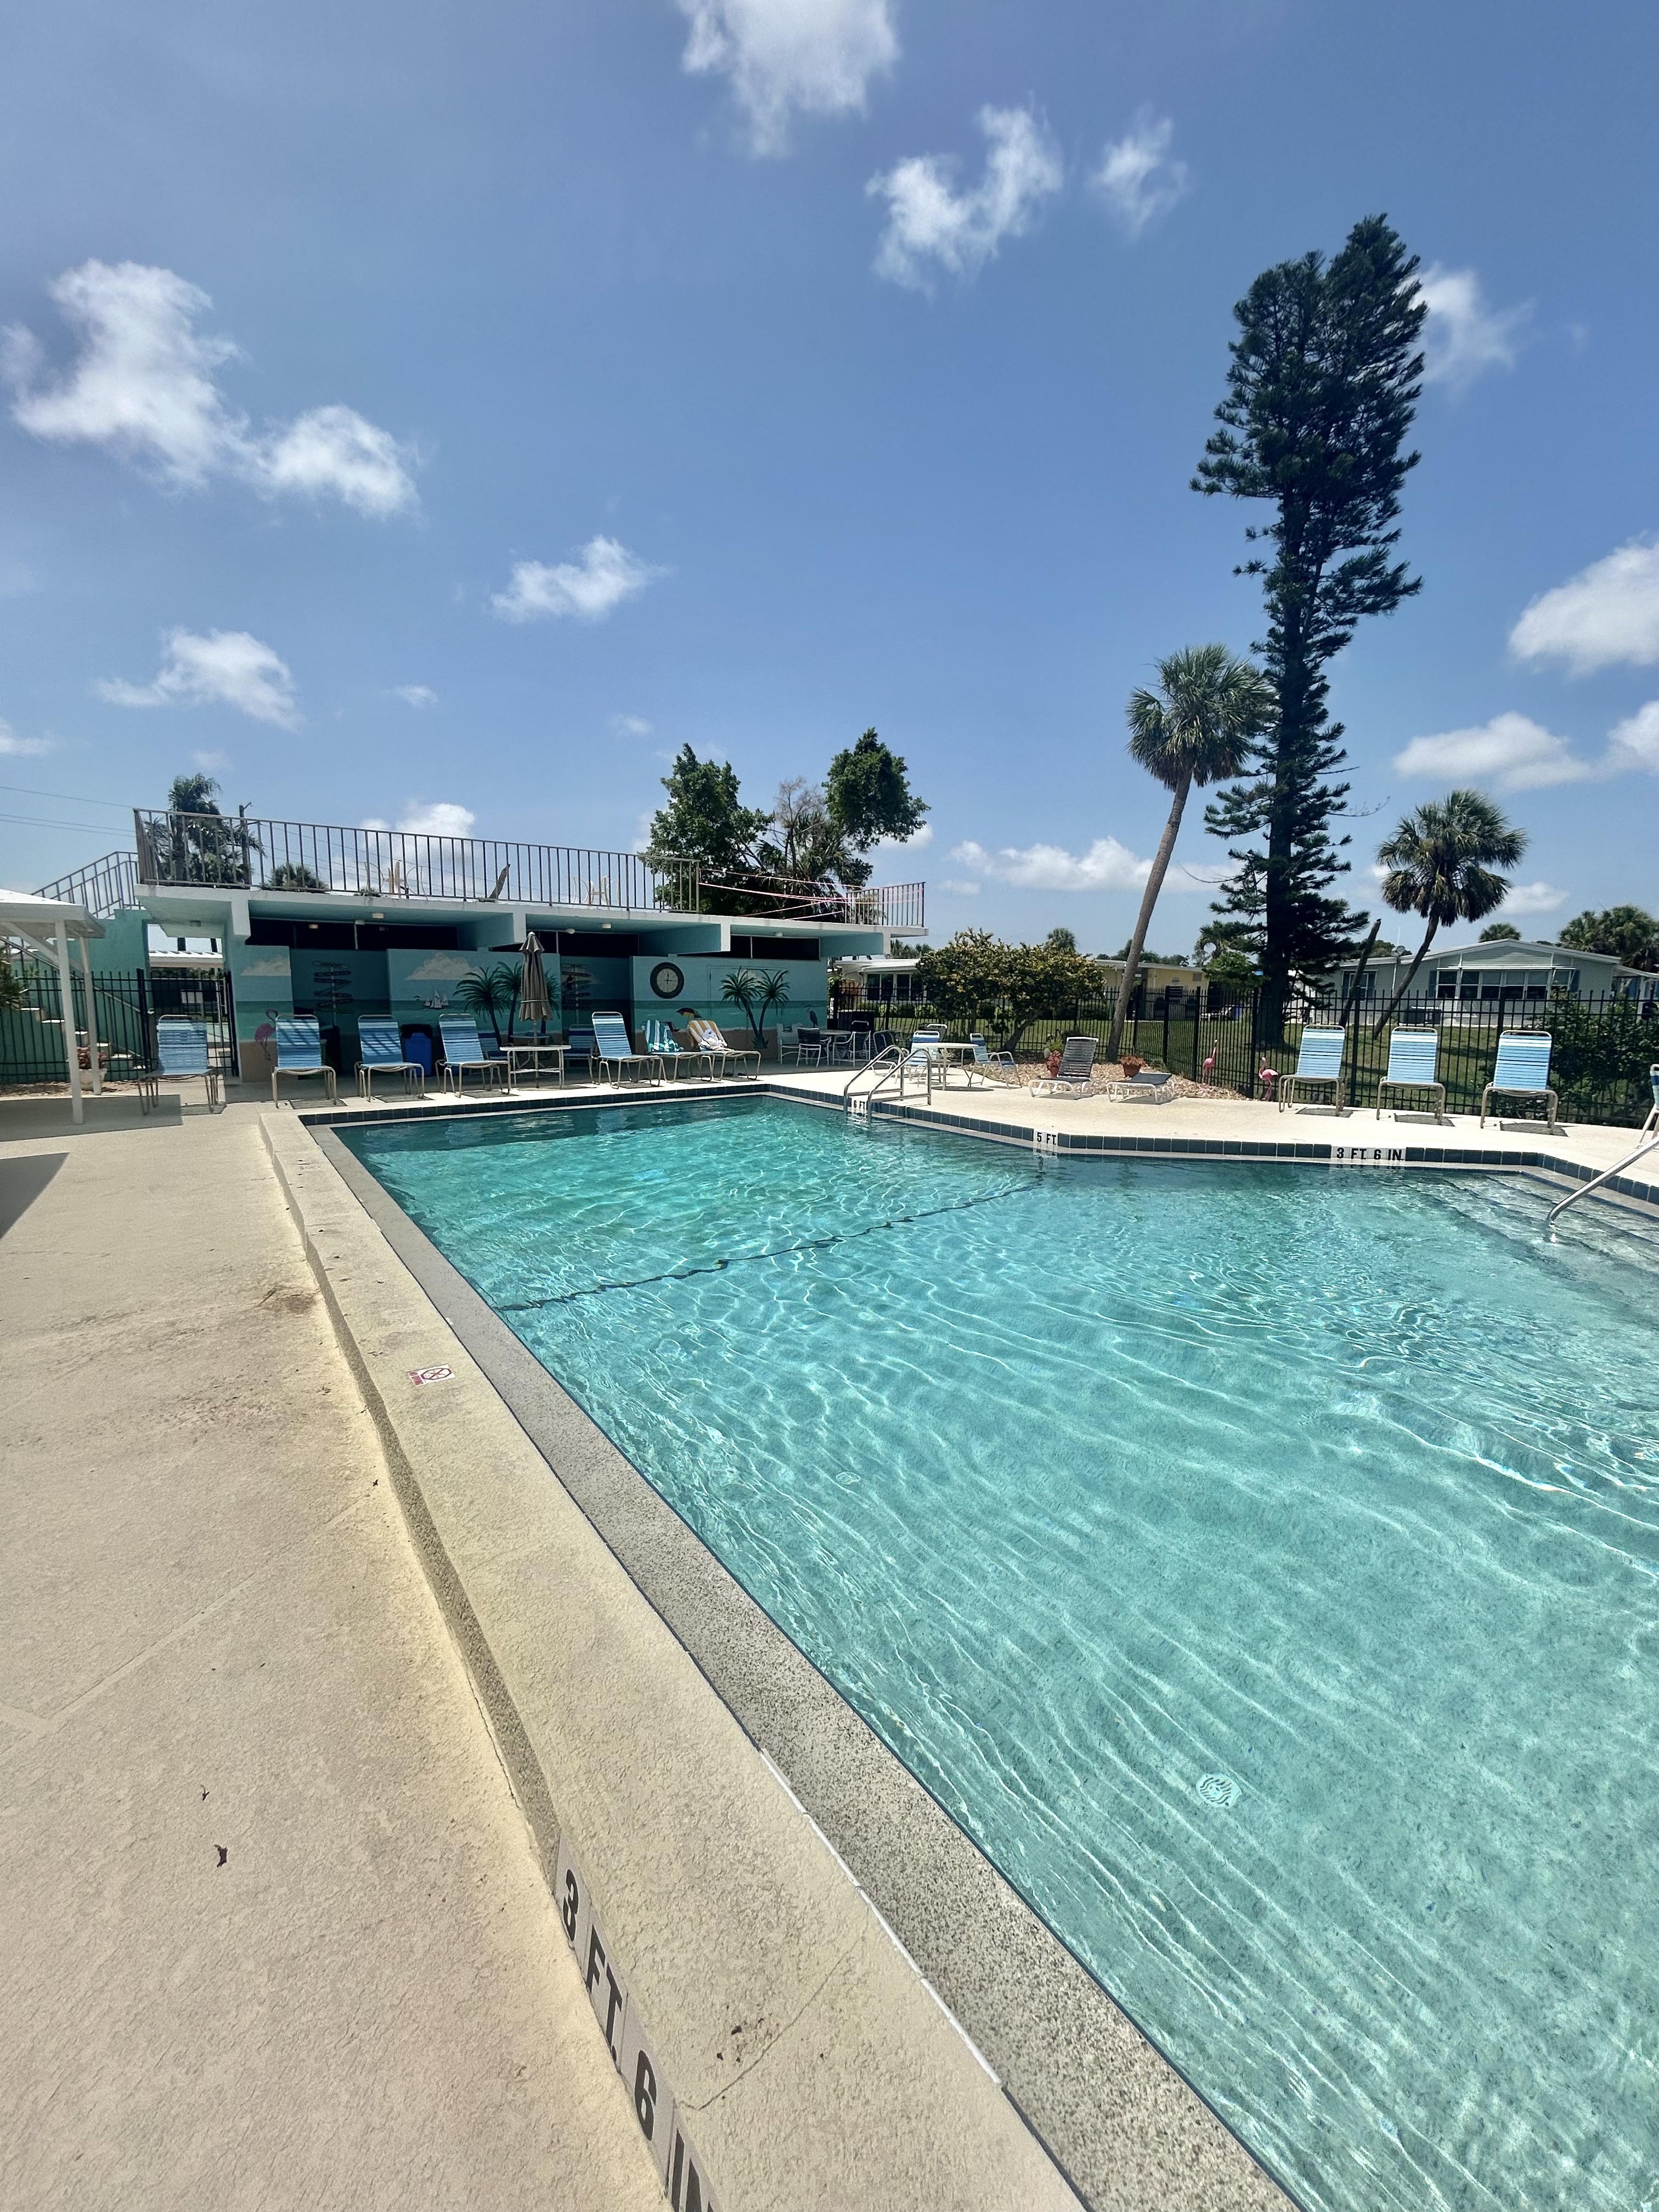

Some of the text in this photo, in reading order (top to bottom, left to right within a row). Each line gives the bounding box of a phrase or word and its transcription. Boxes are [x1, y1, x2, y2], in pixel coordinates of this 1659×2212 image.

[1037, 1132, 1042, 1142] 5
[1336, 1147, 1344, 1158] 3
[1374, 1149, 1381, 1160] 6
[562, 1869, 579, 1941] 3
[634, 2050, 657, 2141] 6
